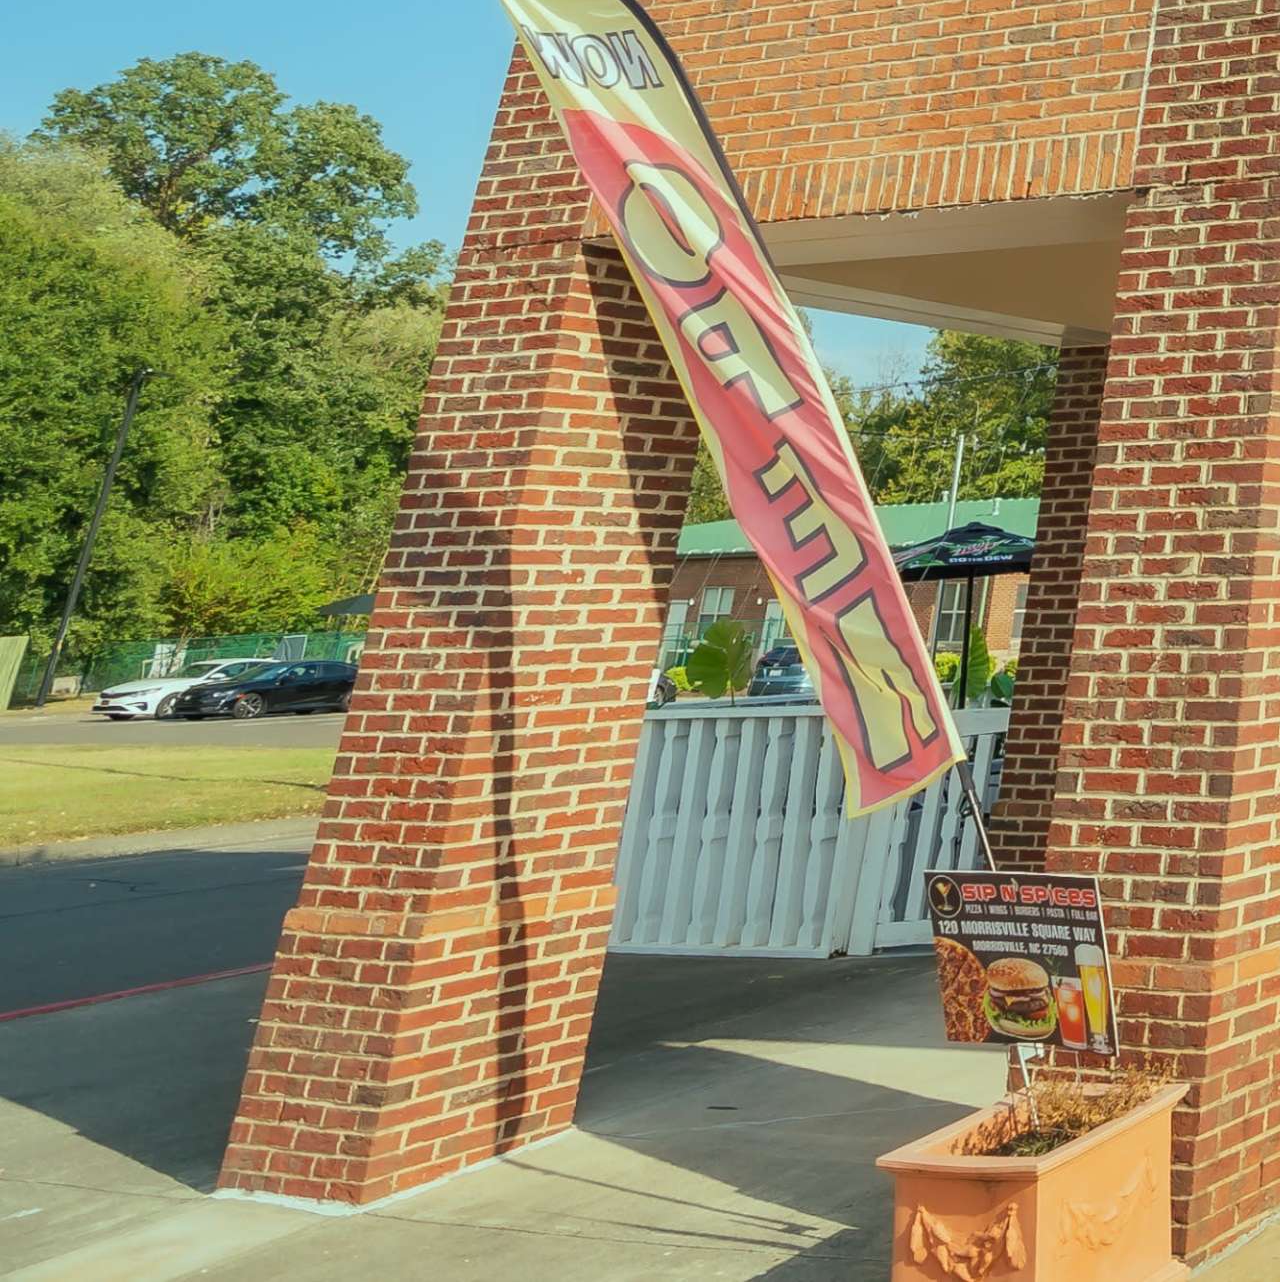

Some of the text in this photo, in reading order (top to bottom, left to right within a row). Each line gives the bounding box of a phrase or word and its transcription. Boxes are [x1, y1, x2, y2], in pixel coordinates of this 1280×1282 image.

[961, 883, 997, 902] SIP
[960, 921, 1030, 937] MORRISVILLE
[1031, 923, 1072, 940] SQUARE
[1072, 926, 1096, 942] WAY
